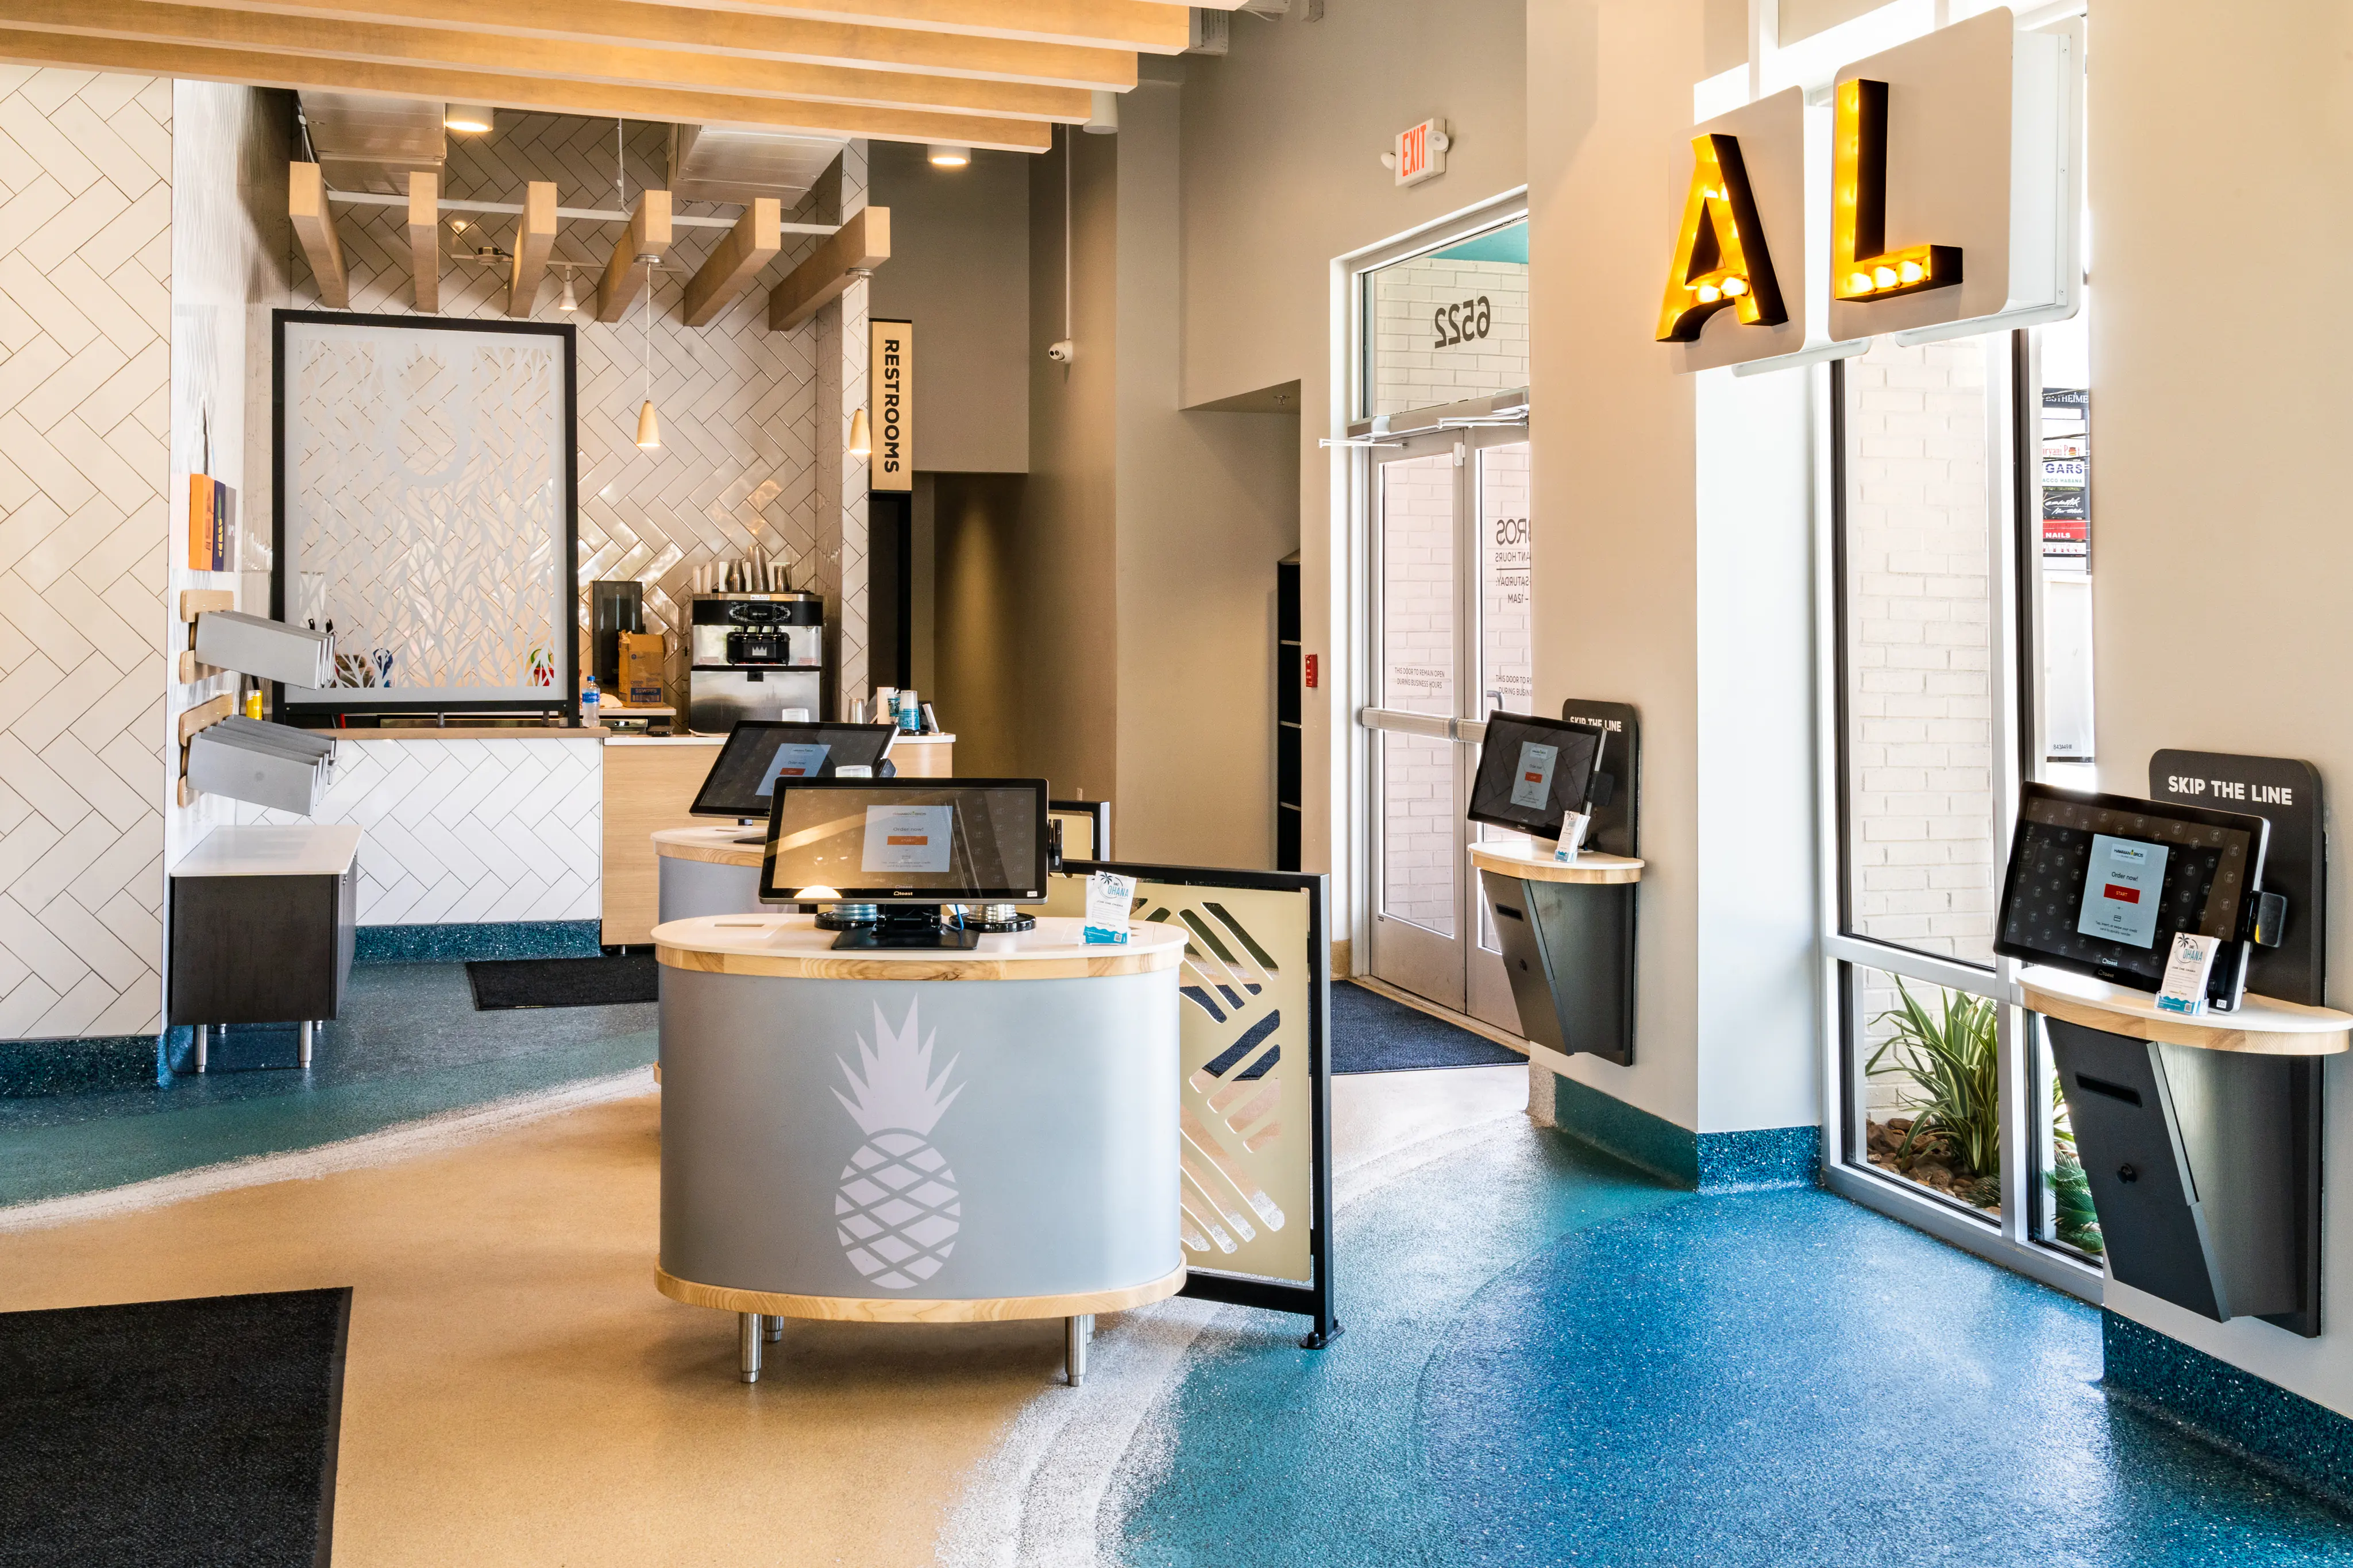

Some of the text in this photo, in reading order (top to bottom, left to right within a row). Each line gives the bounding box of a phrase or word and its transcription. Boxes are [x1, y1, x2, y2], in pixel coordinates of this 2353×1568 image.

[1402, 124, 1426, 176] EXIT
[884, 339, 900, 473] RESTROOMS
[1411, 679, 1429, 688] BUSINESS
[1429, 681, 1442, 689] HOURS
[1496, 674, 1505, 682] THIS
[1506, 675, 1519, 683] DOOR
[1499, 687, 1515, 695] DURING
[1588, 718, 1602, 727] THE
[1604, 720, 1622, 732] LINE
[2168, 775, 2292, 805] SKIP THE LINE
[2111, 871, 2126, 879] Order
[1108, 885, 1128, 897] OHANA
[2183, 948, 2203, 961] OHANA
